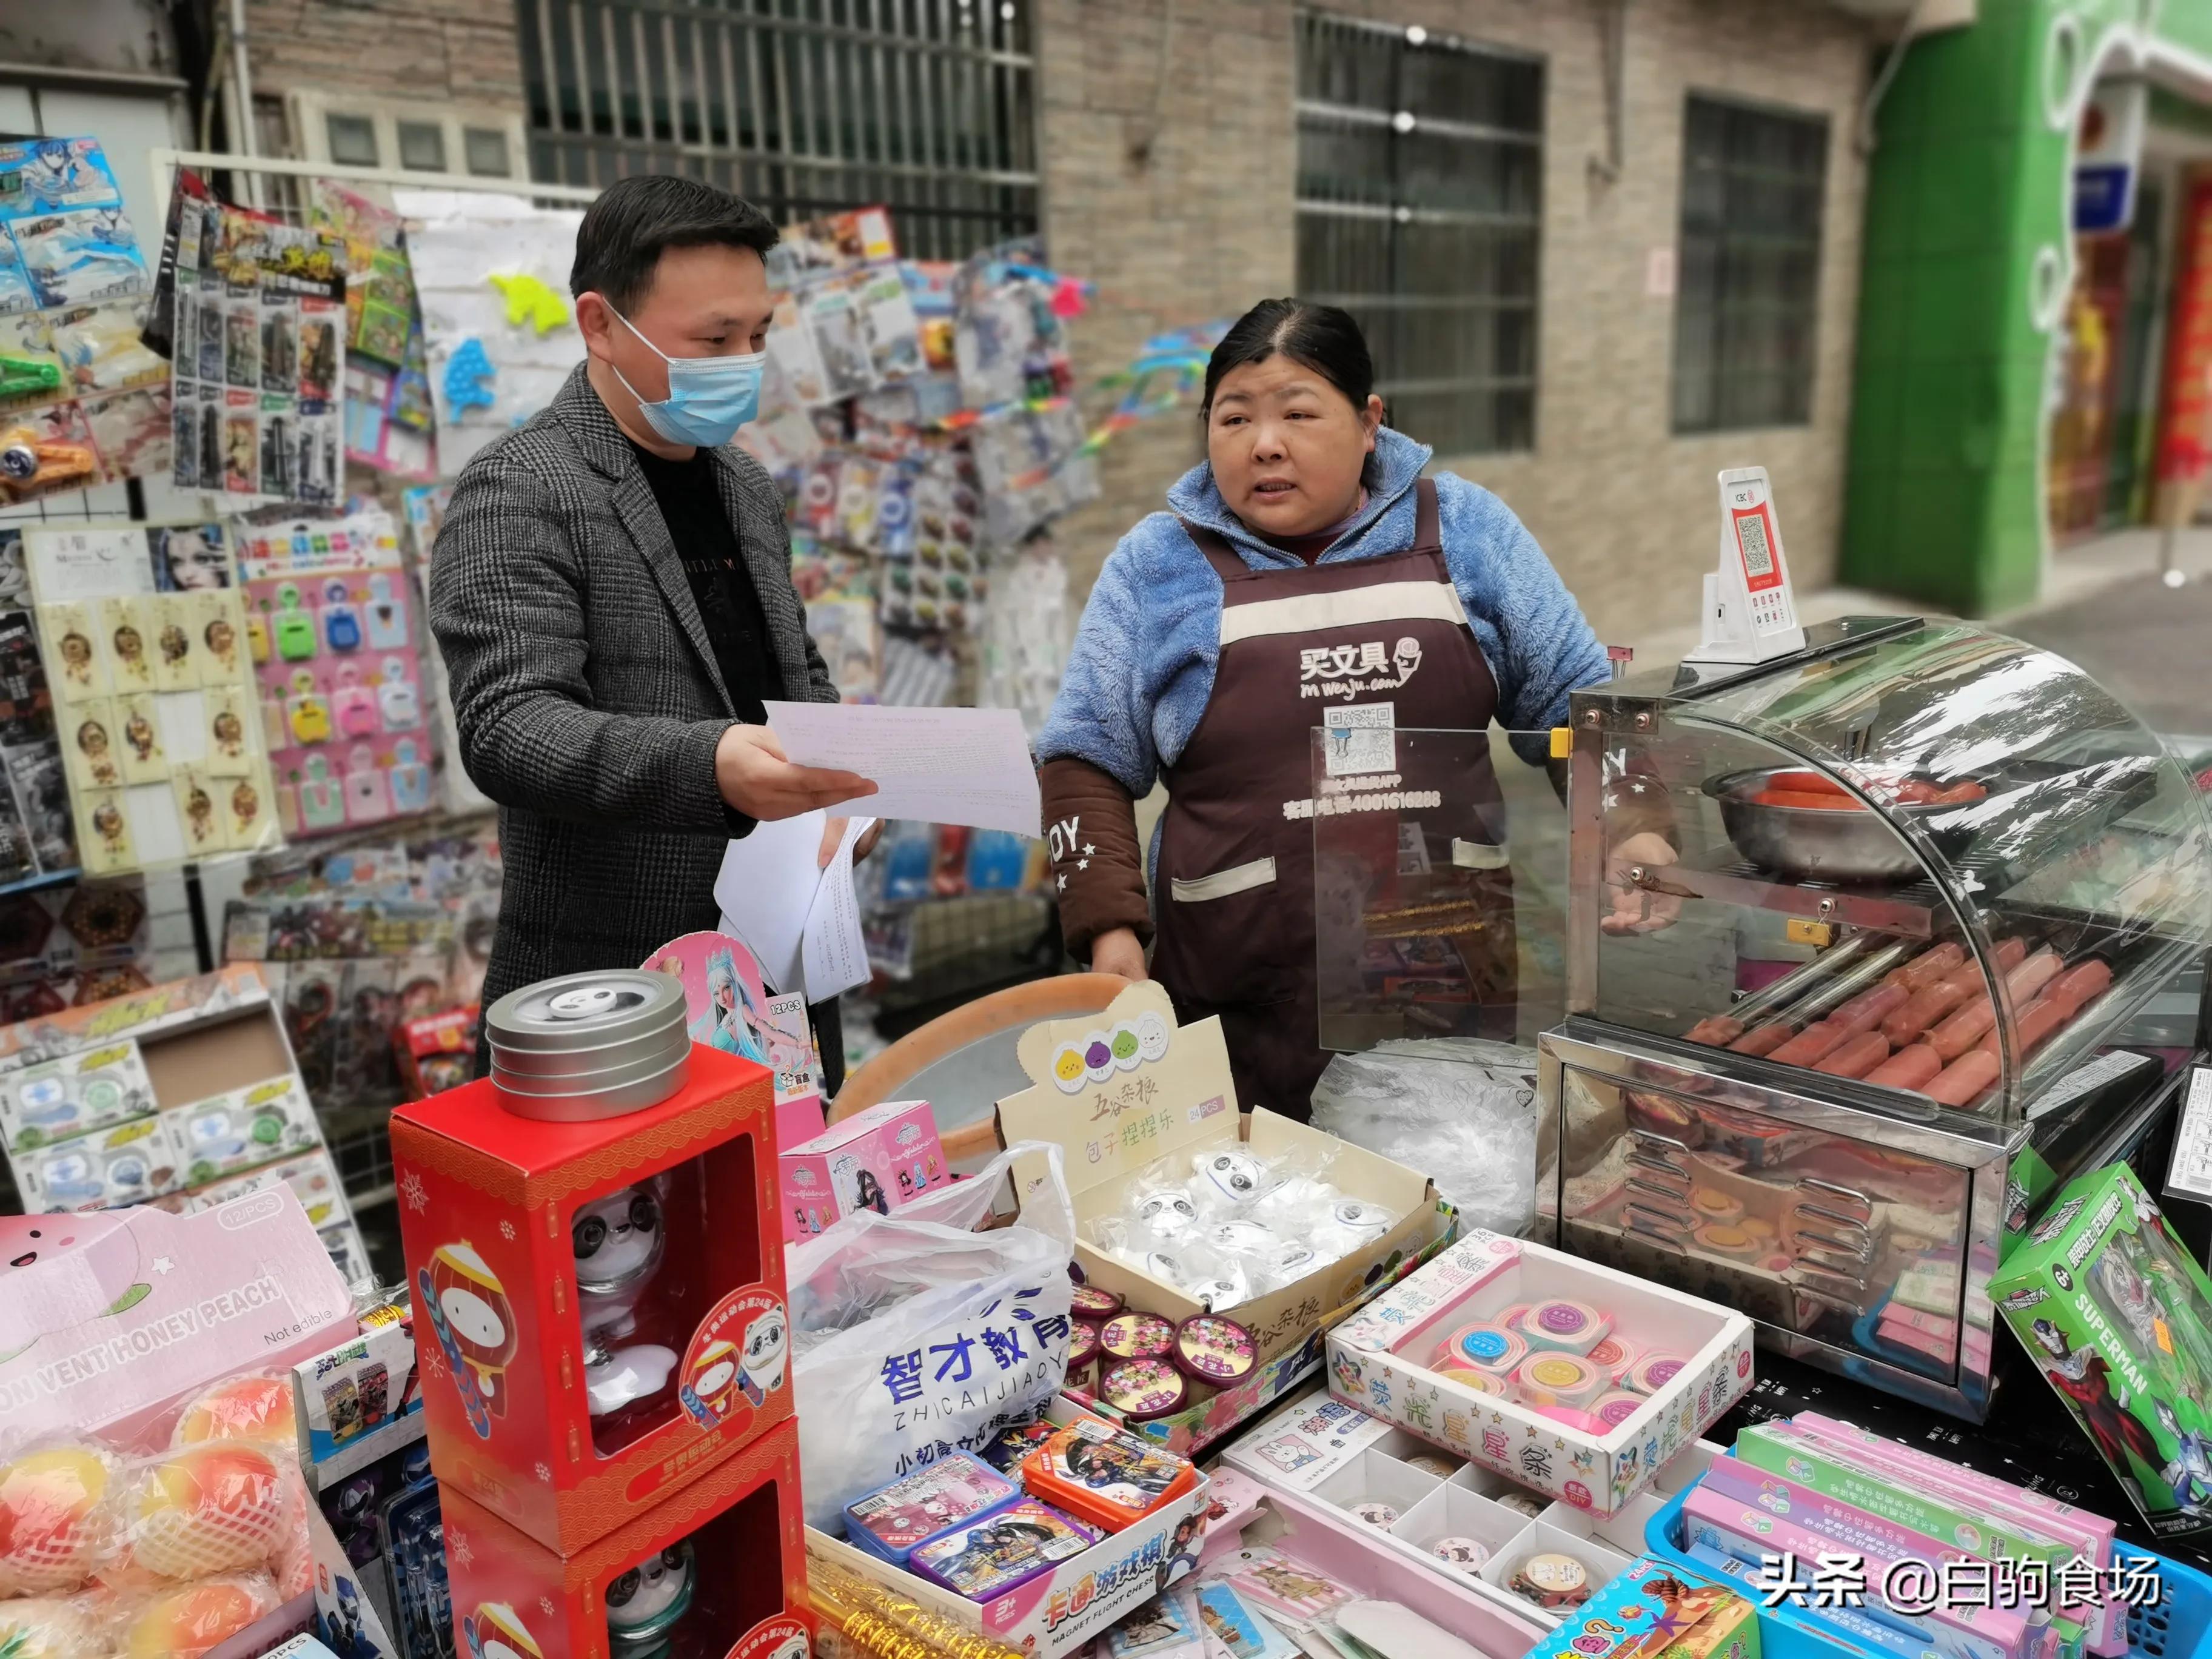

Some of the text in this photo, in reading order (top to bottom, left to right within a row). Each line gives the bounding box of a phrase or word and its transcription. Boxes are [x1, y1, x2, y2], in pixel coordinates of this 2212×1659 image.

[1735, 494, 1747, 503] ICBC
[1300, 641, 1389, 681] 买文具
[771, 1000, 801, 1016] 12PCS
[794, 1071, 811, 1085] 盲盒
[1201, 1101, 1219, 1116] PCS
[1085, 1108, 1175, 1164] 包子捏捏乐
[2054, 1269, 2070, 1288] 6+
[38, 1346, 109, 1393] VENT
[111, 1308, 198, 1364] HONEY
[198, 1275, 284, 1326] PEACH
[264, 1309, 333, 1347] Not edible
[2075, 1293, 2148, 1395] SUPERMAN
[1568, 1482, 1588, 1496] 新款
[1569, 1493, 1587, 1505] DIY
[1042, 1528, 1167, 1632] 卡通游戏棋
[1629, 1560, 1655, 1581] 24PCS
[996, 1596, 1017, 1616] 3+
[1051, 1575, 1154, 1647] MAGNET FLIGHT CHESS
[735, 1626, 795, 1659] 运动会第24届
